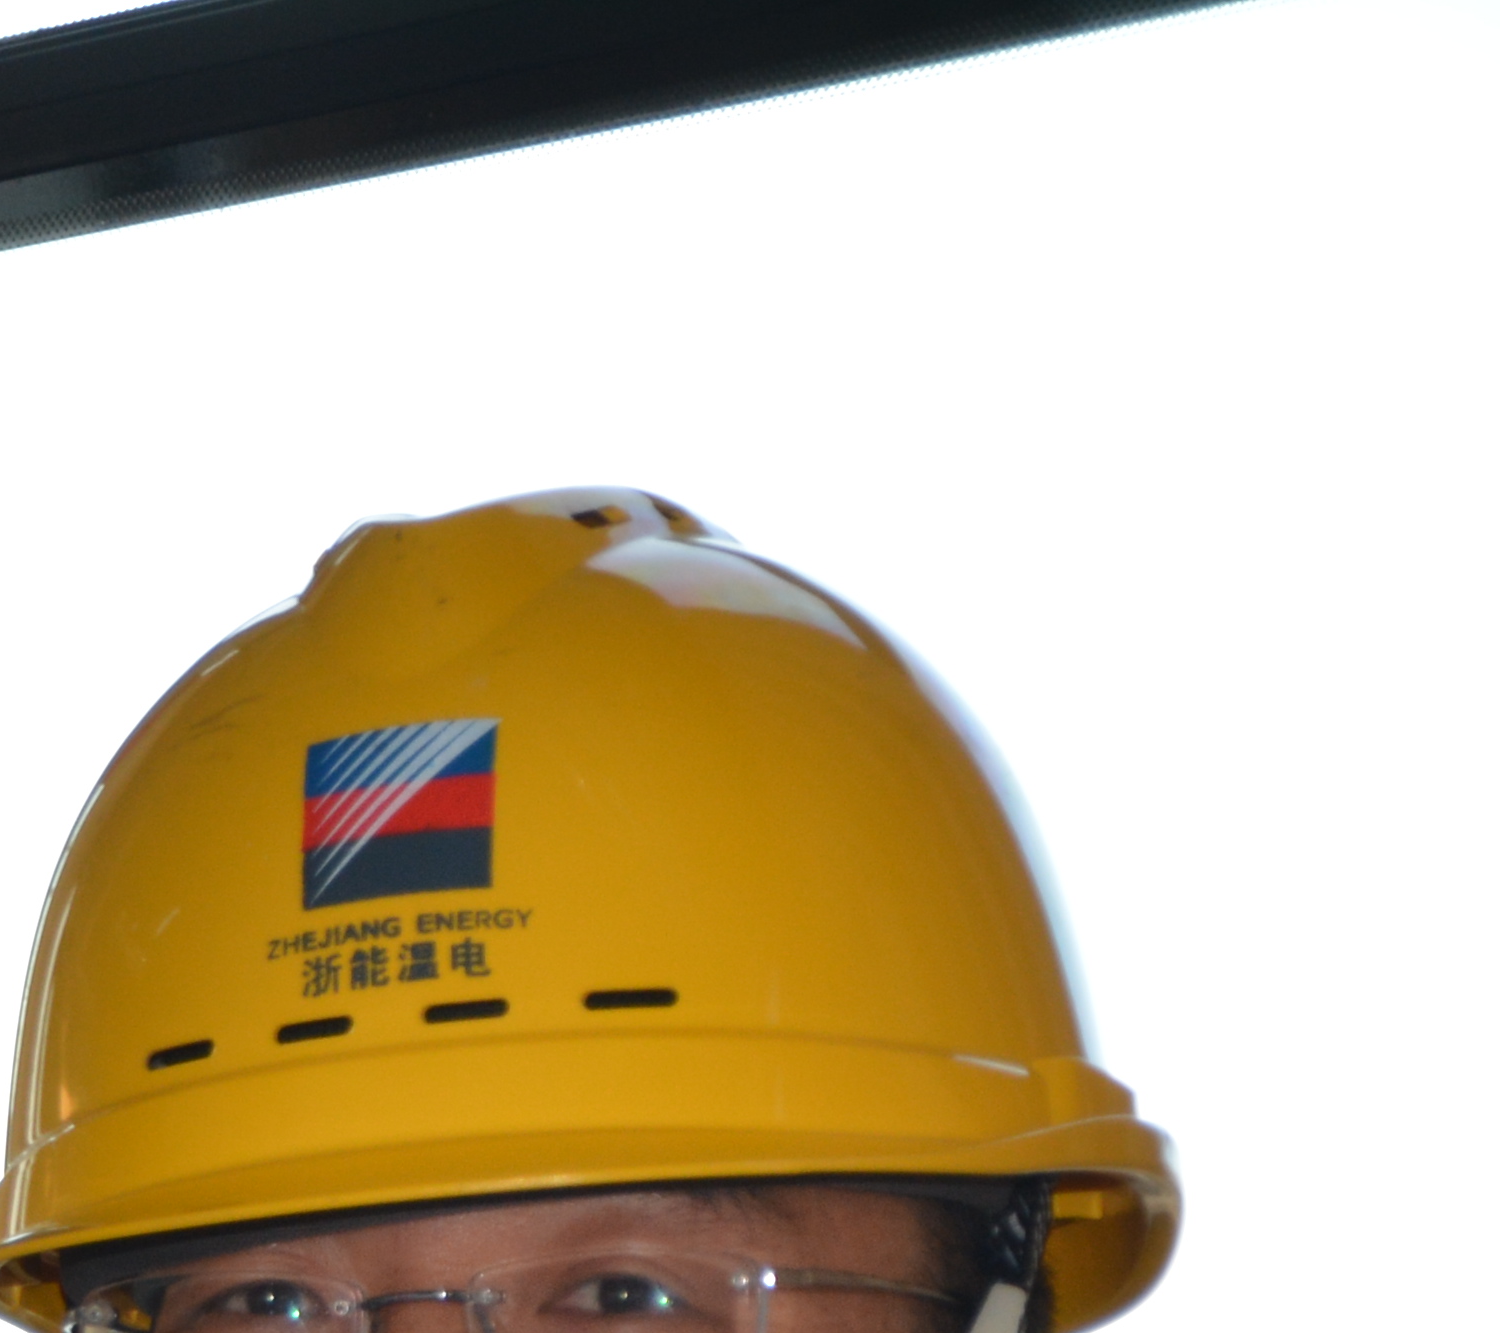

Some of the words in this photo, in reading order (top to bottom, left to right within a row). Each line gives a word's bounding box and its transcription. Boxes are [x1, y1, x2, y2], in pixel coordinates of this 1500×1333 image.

[267, 916, 402, 961] ZHEJIANG
[415, 909, 532, 934] ENERGY
[302, 937, 492, 998] 浙能温电
